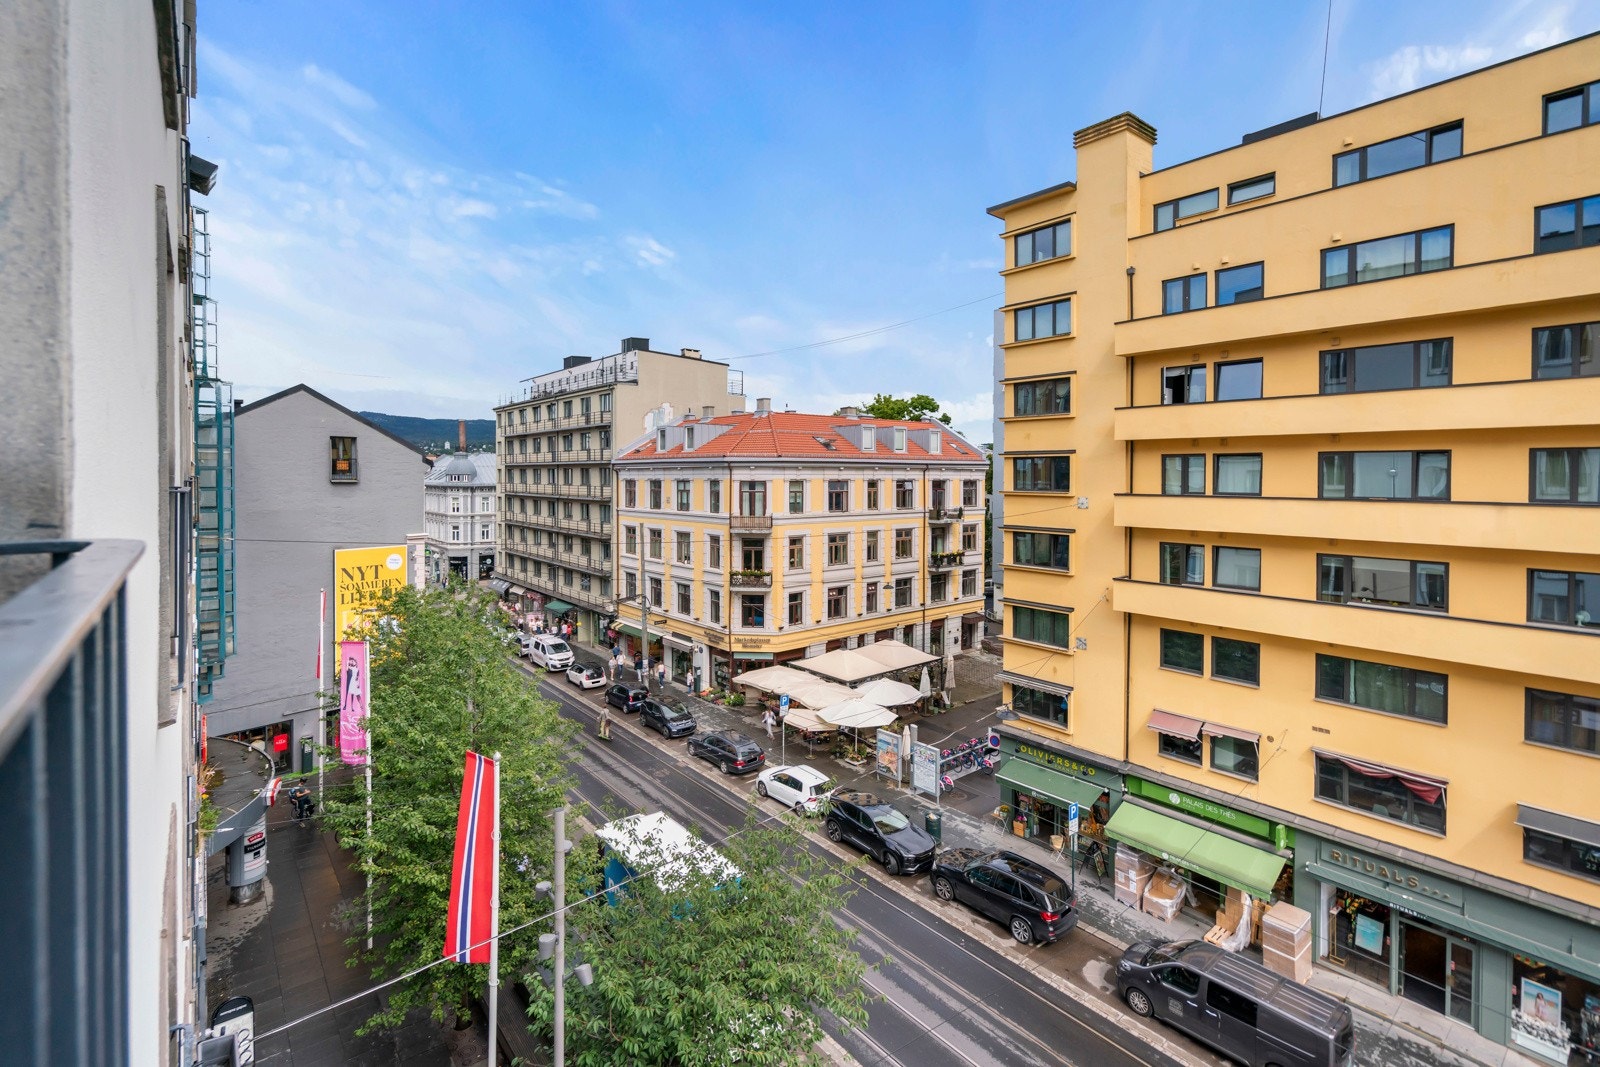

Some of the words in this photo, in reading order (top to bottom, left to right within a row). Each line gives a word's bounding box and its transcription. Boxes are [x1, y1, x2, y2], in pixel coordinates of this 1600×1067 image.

[340, 564, 384, 583] NYT
[339, 577, 402, 592] SOMMEREN
[1070, 805, 1077, 819] P
[1182, 796, 1204, 809] PALAIS
[1205, 804, 1219, 814] DES
